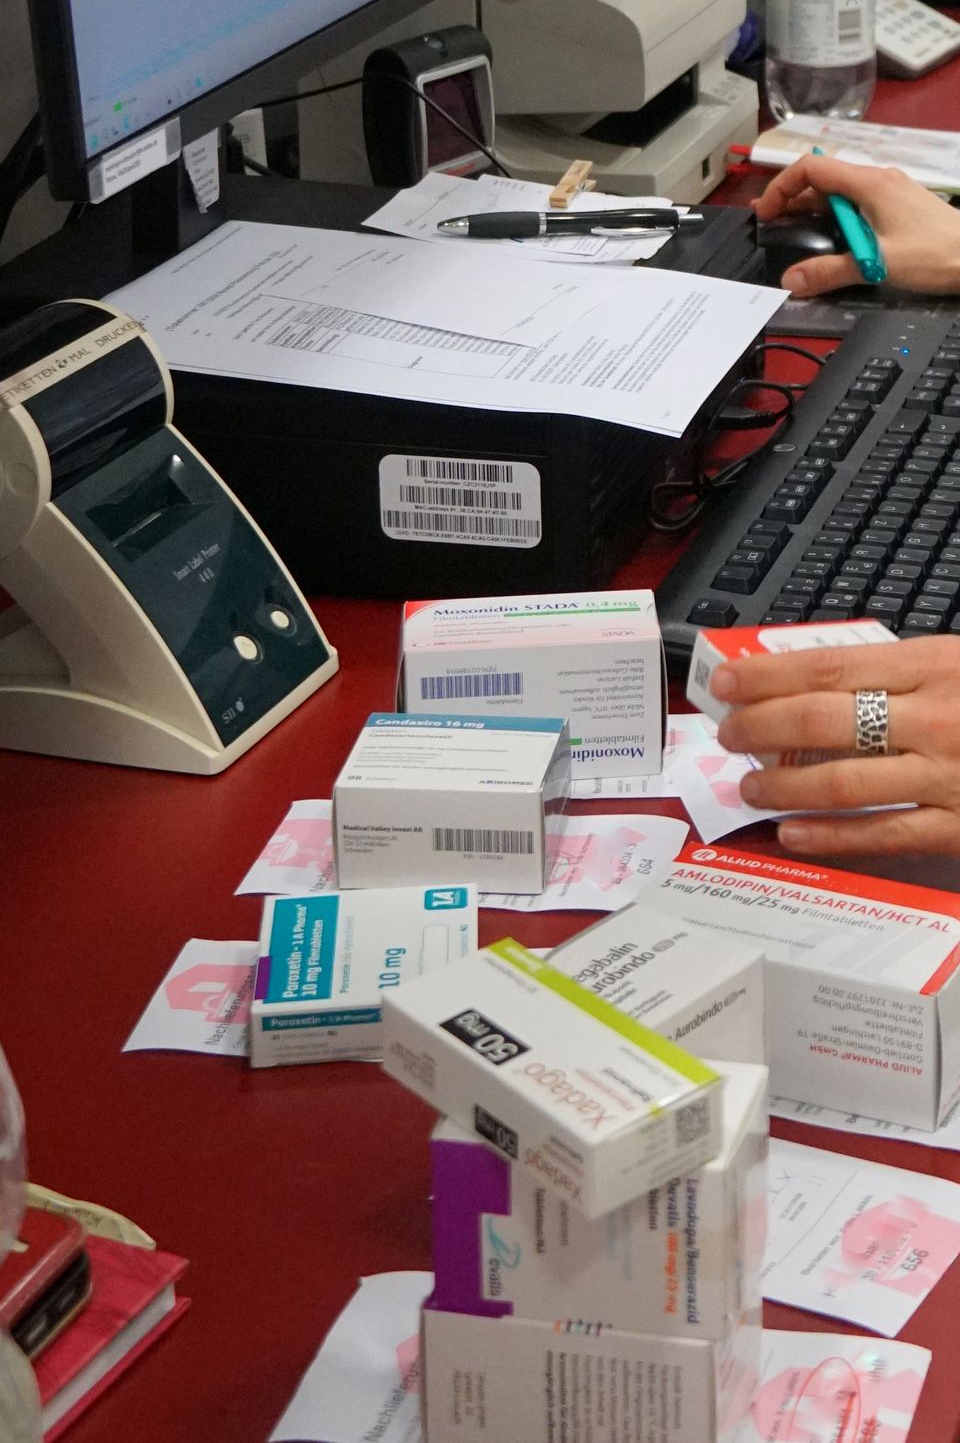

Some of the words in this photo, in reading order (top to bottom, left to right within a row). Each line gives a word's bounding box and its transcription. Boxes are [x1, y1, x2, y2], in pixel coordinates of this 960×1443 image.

[69, 348, 92, 363] MAL
[433, 606, 519, 616] Moxonidin
[375, 718, 442, 727] Candaxiro
[445, 719, 462, 728] 16
[464, 721, 485, 730] mg
[584, 735, 645, 745] Filmtabletten
[716, 853, 761, 869] ALIUD
[671, 868, 926, 928] AMLODIPIN/VALSARTAN/HCT
[927, 918, 951, 934] AL
[673, 881, 731, 900] mg/160
[731, 891, 778, 910] mg/25
[780, 902, 800, 916] mg
[802, 906, 885, 933] Filmtabletten
[308, 919, 324, 966] Filmtabletten
[385, 947, 407, 969] mg
[572, 942, 639, 983] egabalin
[282, 952, 303, 999] Paroxetin
[307, 966, 322, 982] mg
[378, 972, 401, 989] 10
[592, 951, 655, 993] urobindo
[301, 983, 317, 997] 10
[271, 1016, 321, 1027] Paroxetin
[454, 1012, 491, 1038] mg
[675, 1001, 724, 1041] Aurobindo
[865, 1020, 923, 1040] Filmtablette
[832, 1024, 881, 1042] Laichingen
[473, 1033, 519, 1064] 50
[810, 1044, 839, 1057] GmbH
[812, 1032, 923, 1064] Gottlieb-Daimler-Straße
[892, 1062, 923, 1075] ALIUD
[524, 1062, 619, 1130] Xadago
[648, 1188, 660, 1231] bletten
[902, 1249, 929, 1271] 656
